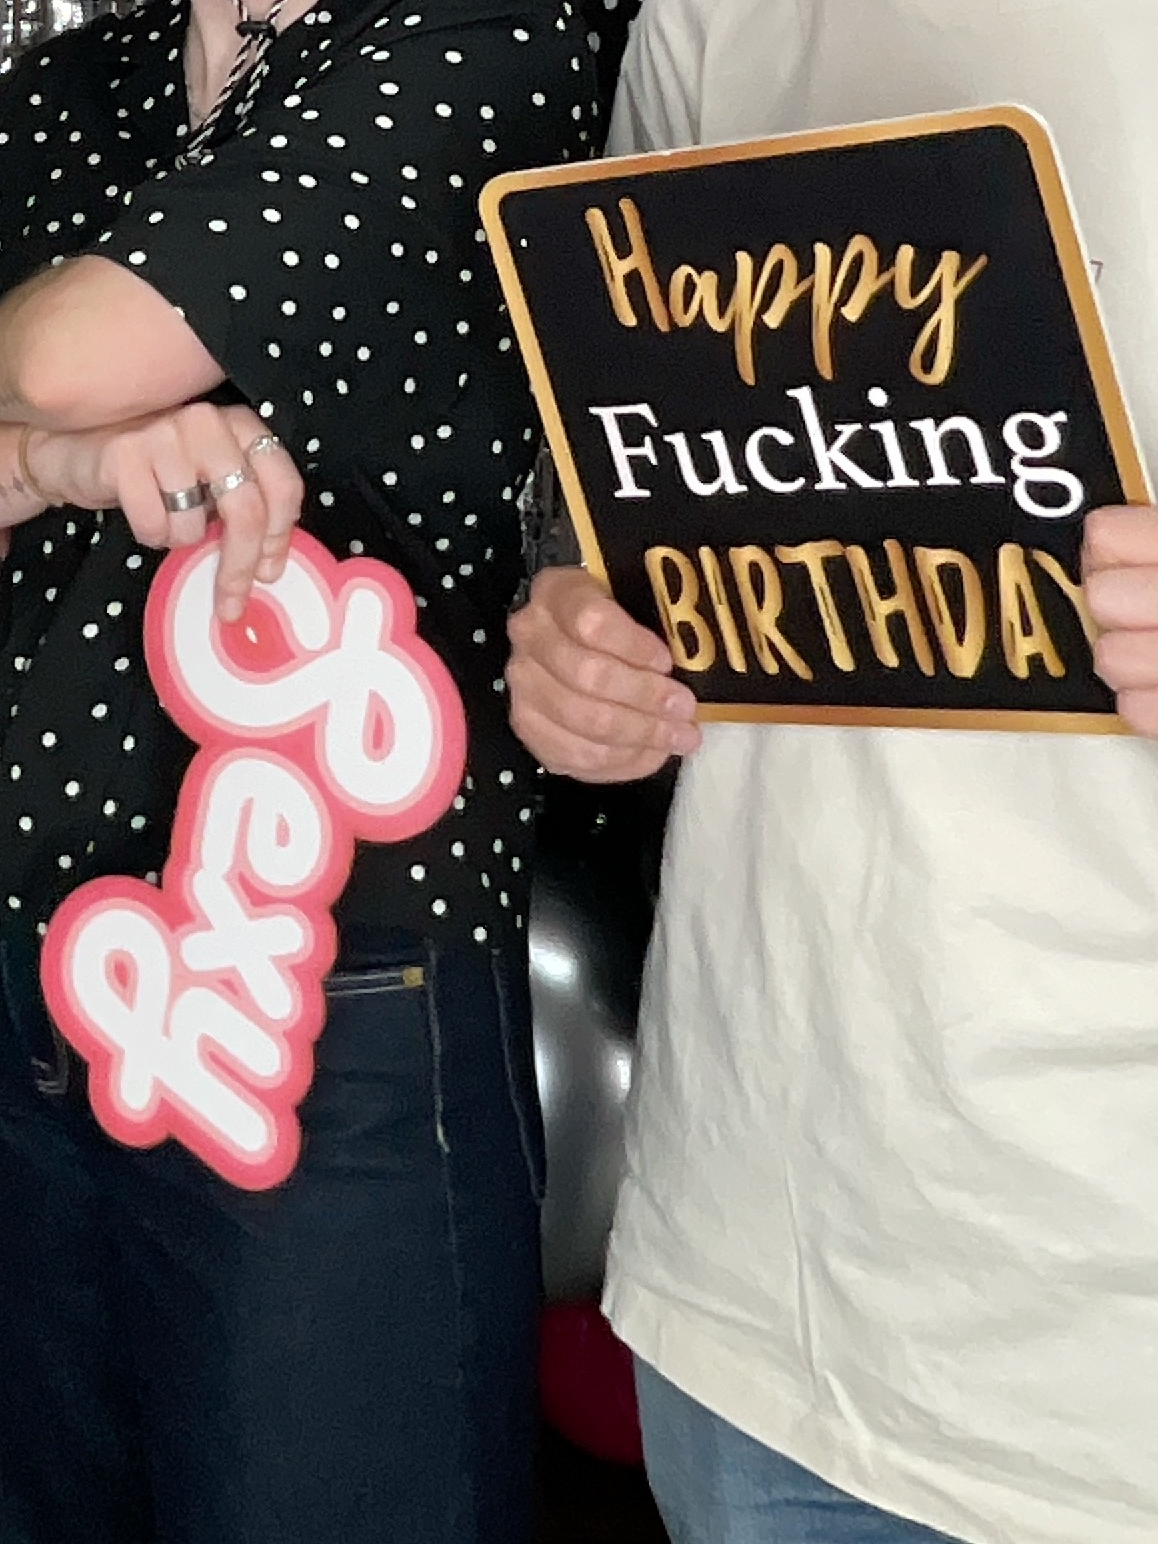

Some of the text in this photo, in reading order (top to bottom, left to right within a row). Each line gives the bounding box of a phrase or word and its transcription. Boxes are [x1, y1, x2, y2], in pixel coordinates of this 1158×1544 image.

[585, 198, 988, 385] Happy
[589, 386, 1084, 518] Fucking
[71, 546, 434, 1154] Sexy
